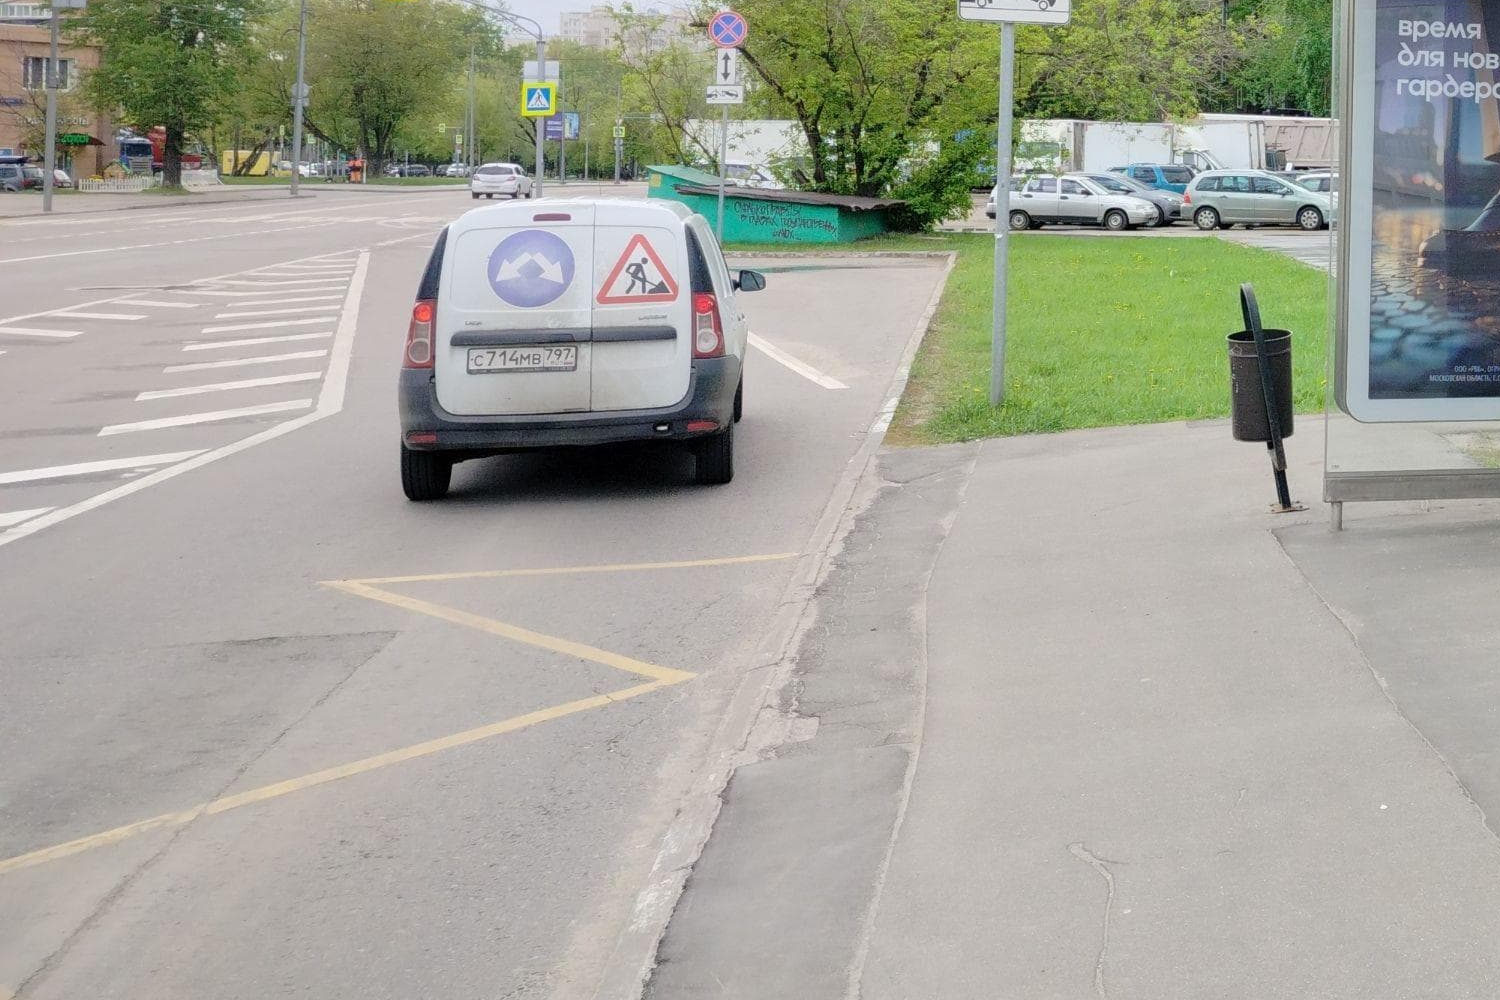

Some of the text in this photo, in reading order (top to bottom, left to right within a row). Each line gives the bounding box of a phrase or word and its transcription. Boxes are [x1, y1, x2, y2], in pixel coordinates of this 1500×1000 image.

[1398, 19, 1482, 42] время
[1397, 42, 1445, 67] для
[545, 348, 571, 361] 797
